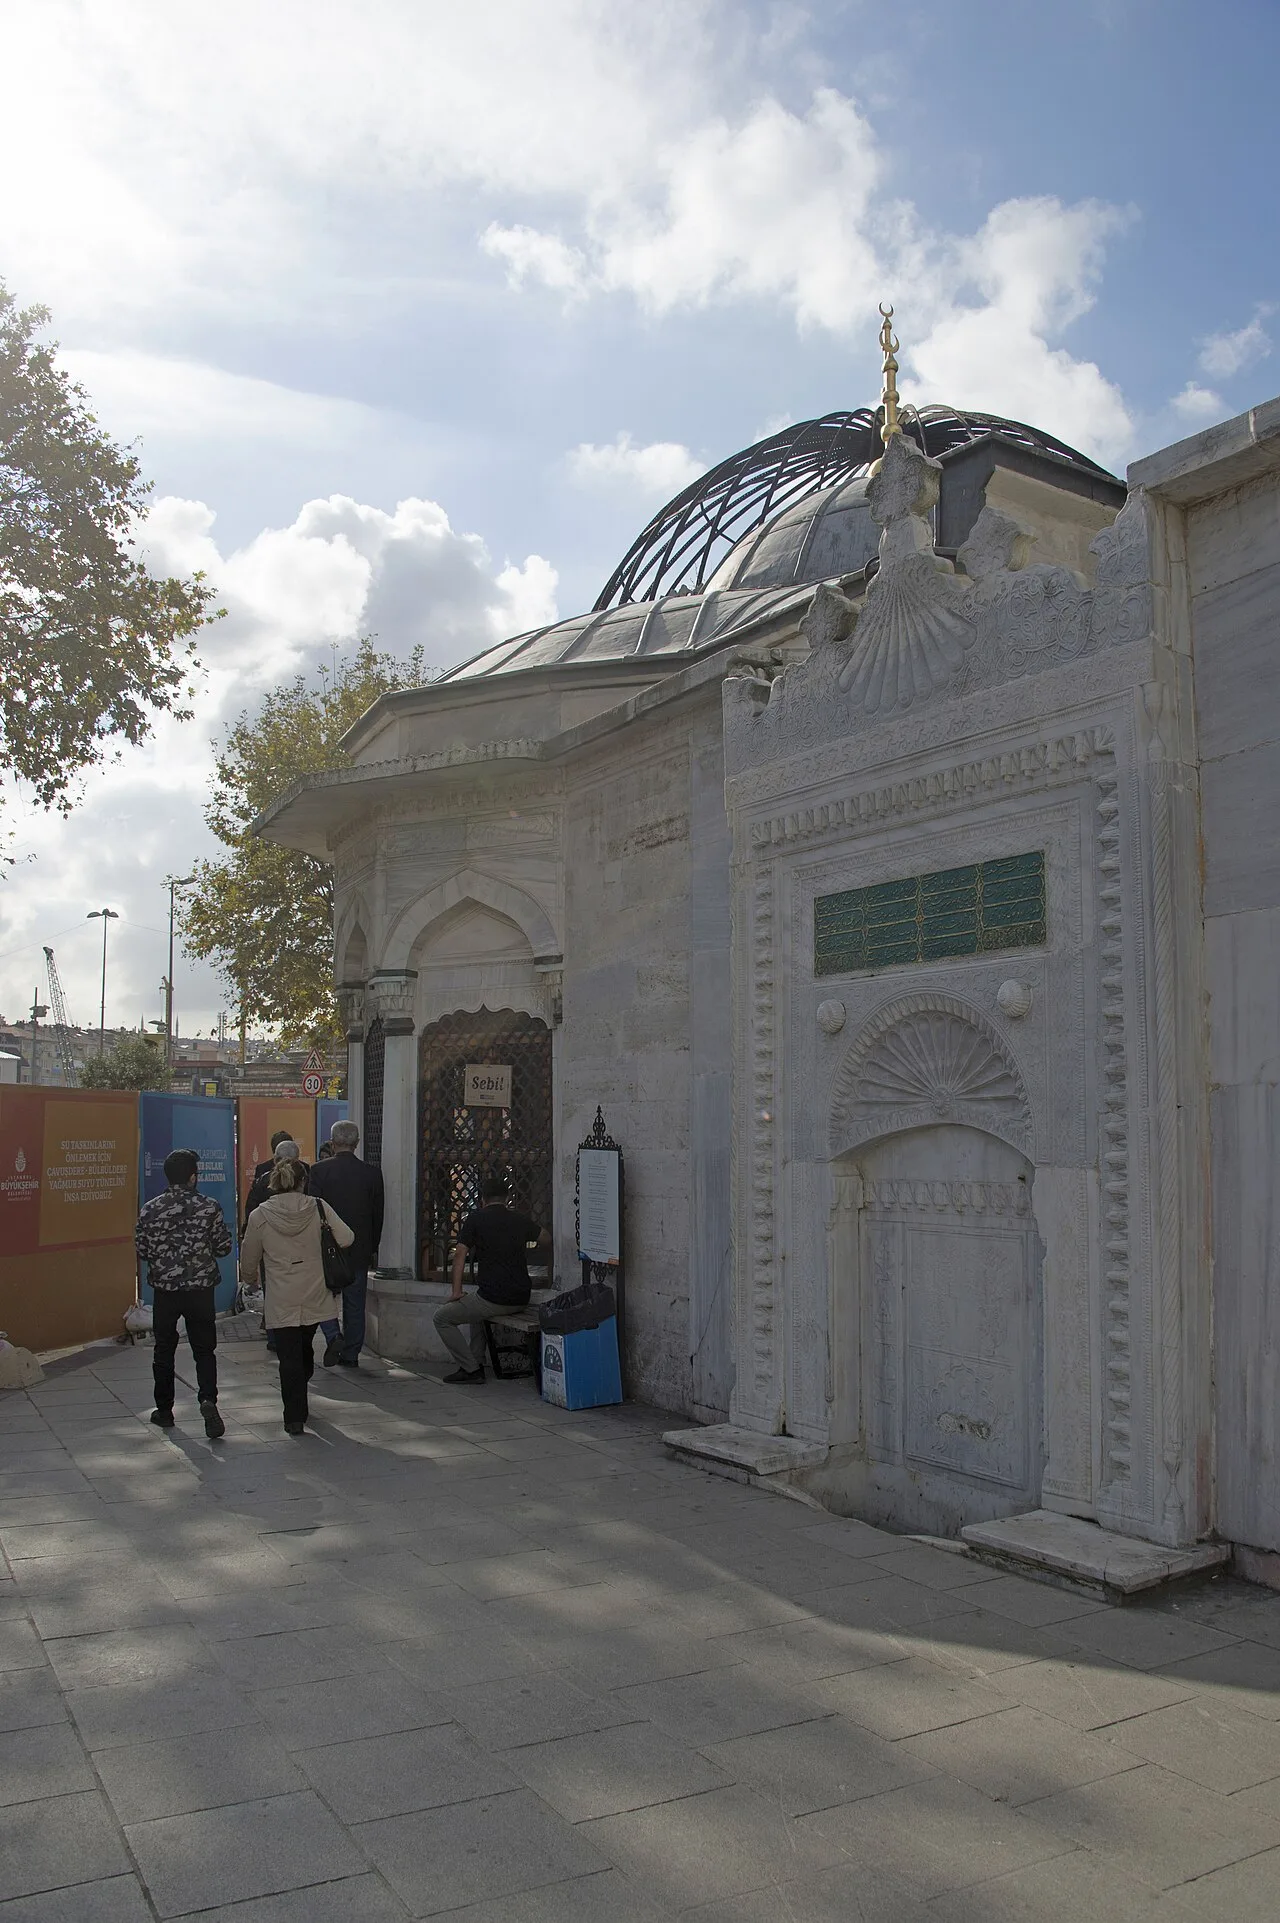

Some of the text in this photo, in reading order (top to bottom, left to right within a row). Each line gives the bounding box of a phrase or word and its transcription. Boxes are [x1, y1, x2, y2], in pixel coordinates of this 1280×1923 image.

[307, 1078, 319, 1090] 30
[471, 1076, 504, 1091] Sebil
[61, 1141, 69, 1150] SU
[65, 1151, 112, 1164] ÖNLEMEK İÇİN
[1, 1180, 39, 1191] BÜYÜKŞEHİR
[48, 1178, 77, 1190] YAĞMUR
[77, 1178, 95, 1189] SUYU
[64, 1191, 79, 1204] İNŞA
